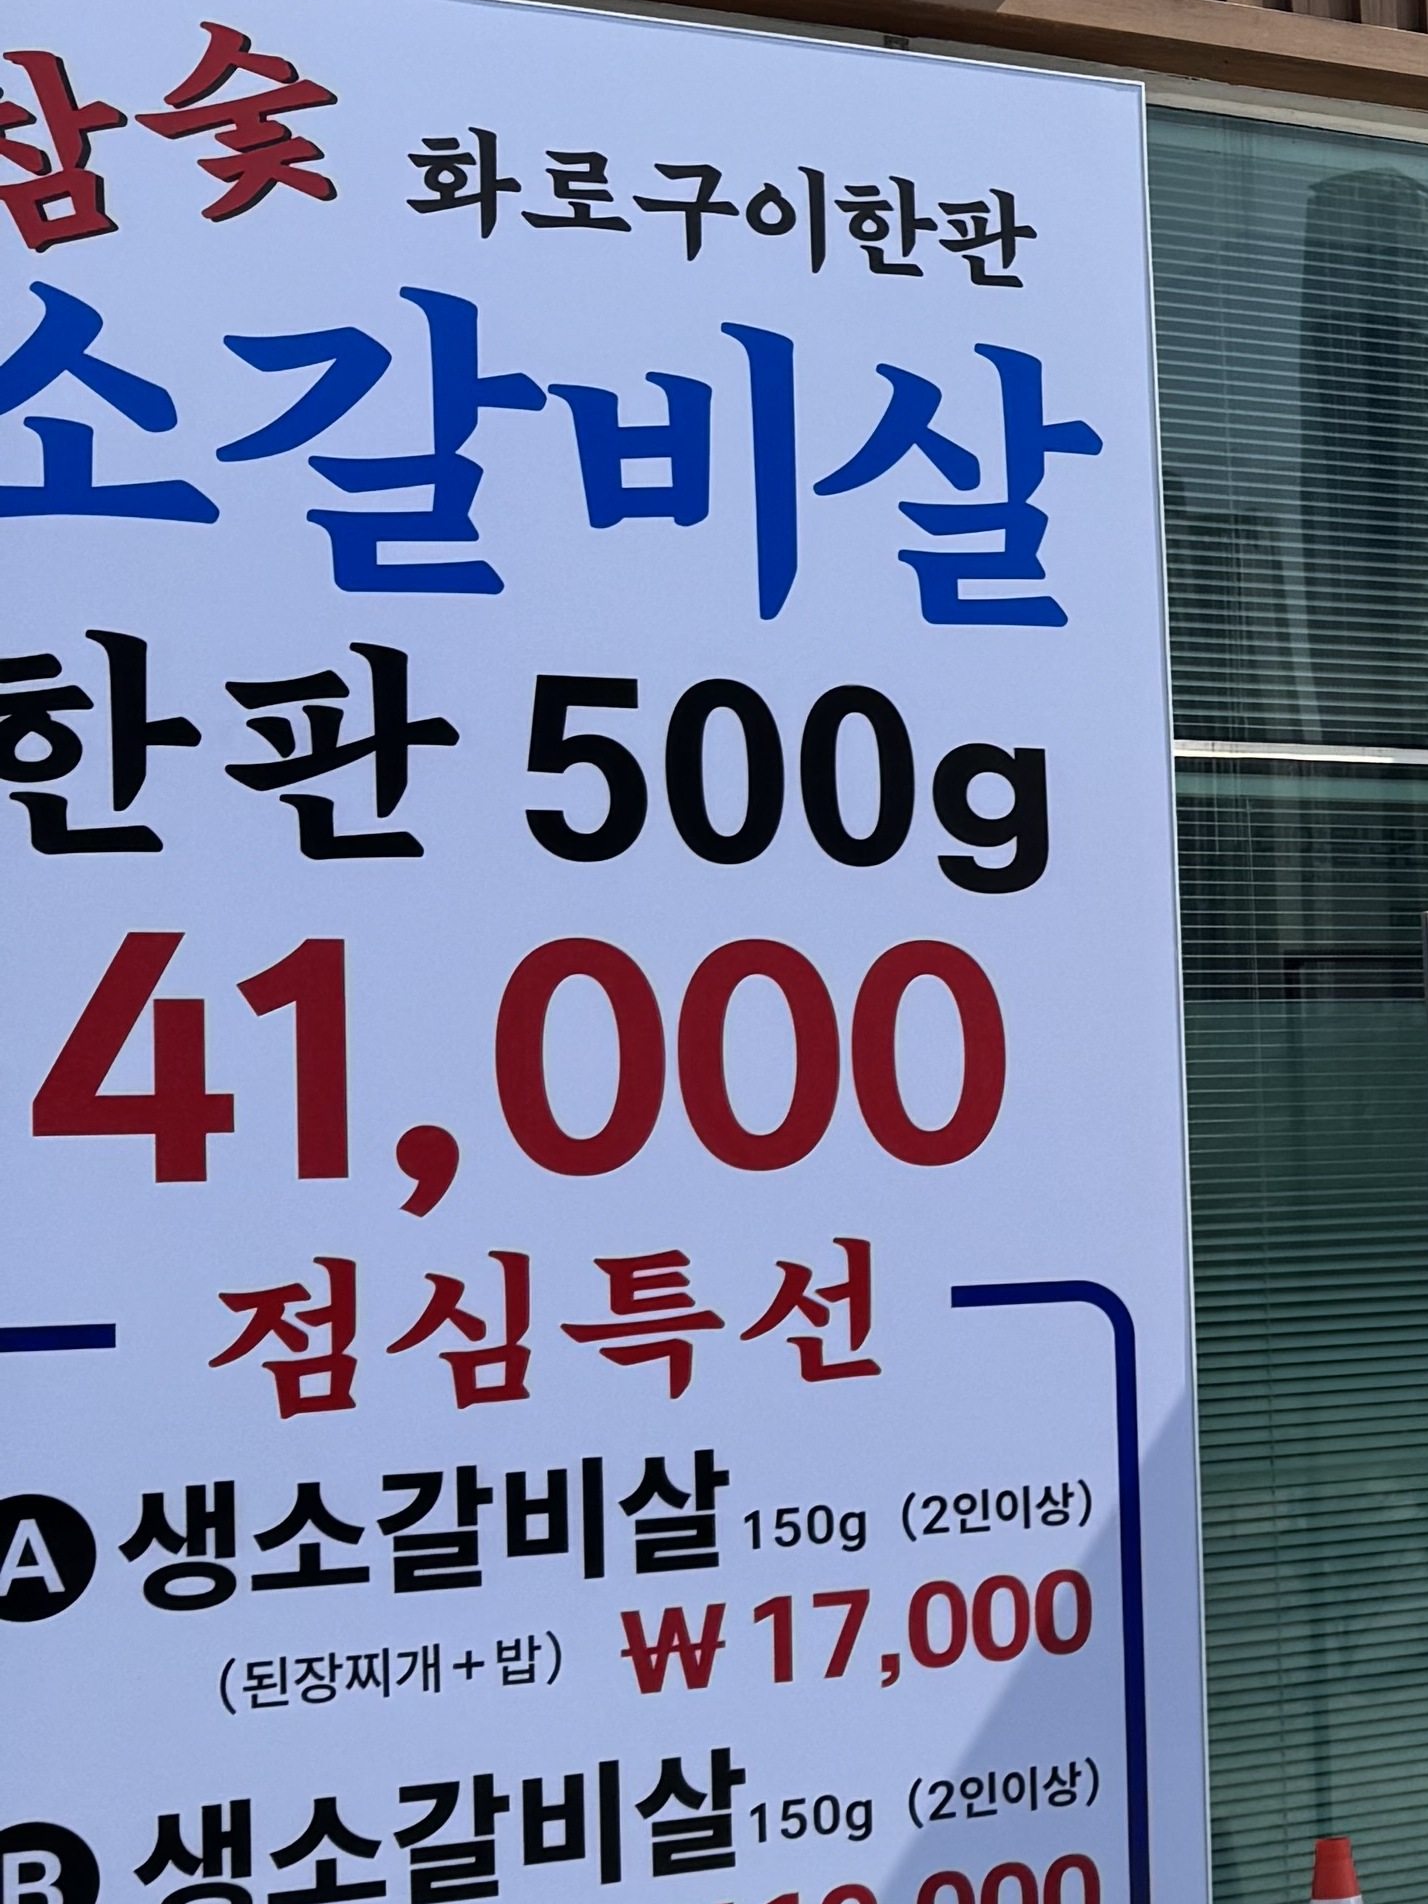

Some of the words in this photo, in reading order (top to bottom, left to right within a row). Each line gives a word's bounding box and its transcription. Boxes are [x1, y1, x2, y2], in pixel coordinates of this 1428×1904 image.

[405, 126, 1038, 288] 화로구이한판
[0, 281, 1104, 628] 소갈비살
[525, 674, 1049, 895] 500g
[32, 931, 1007, 1217] 41,000
[208, 1237, 882, 1421] 점심특선
[118, 1449, 730, 1612] 생소갈비살
[743, 1504, 868, 1552] 150g
[901, 1479, 1093, 1542] (2인이상)
[750, 1795, 874, 1843] 150g
[908, 1757, 1100, 1829] (2인이상)
